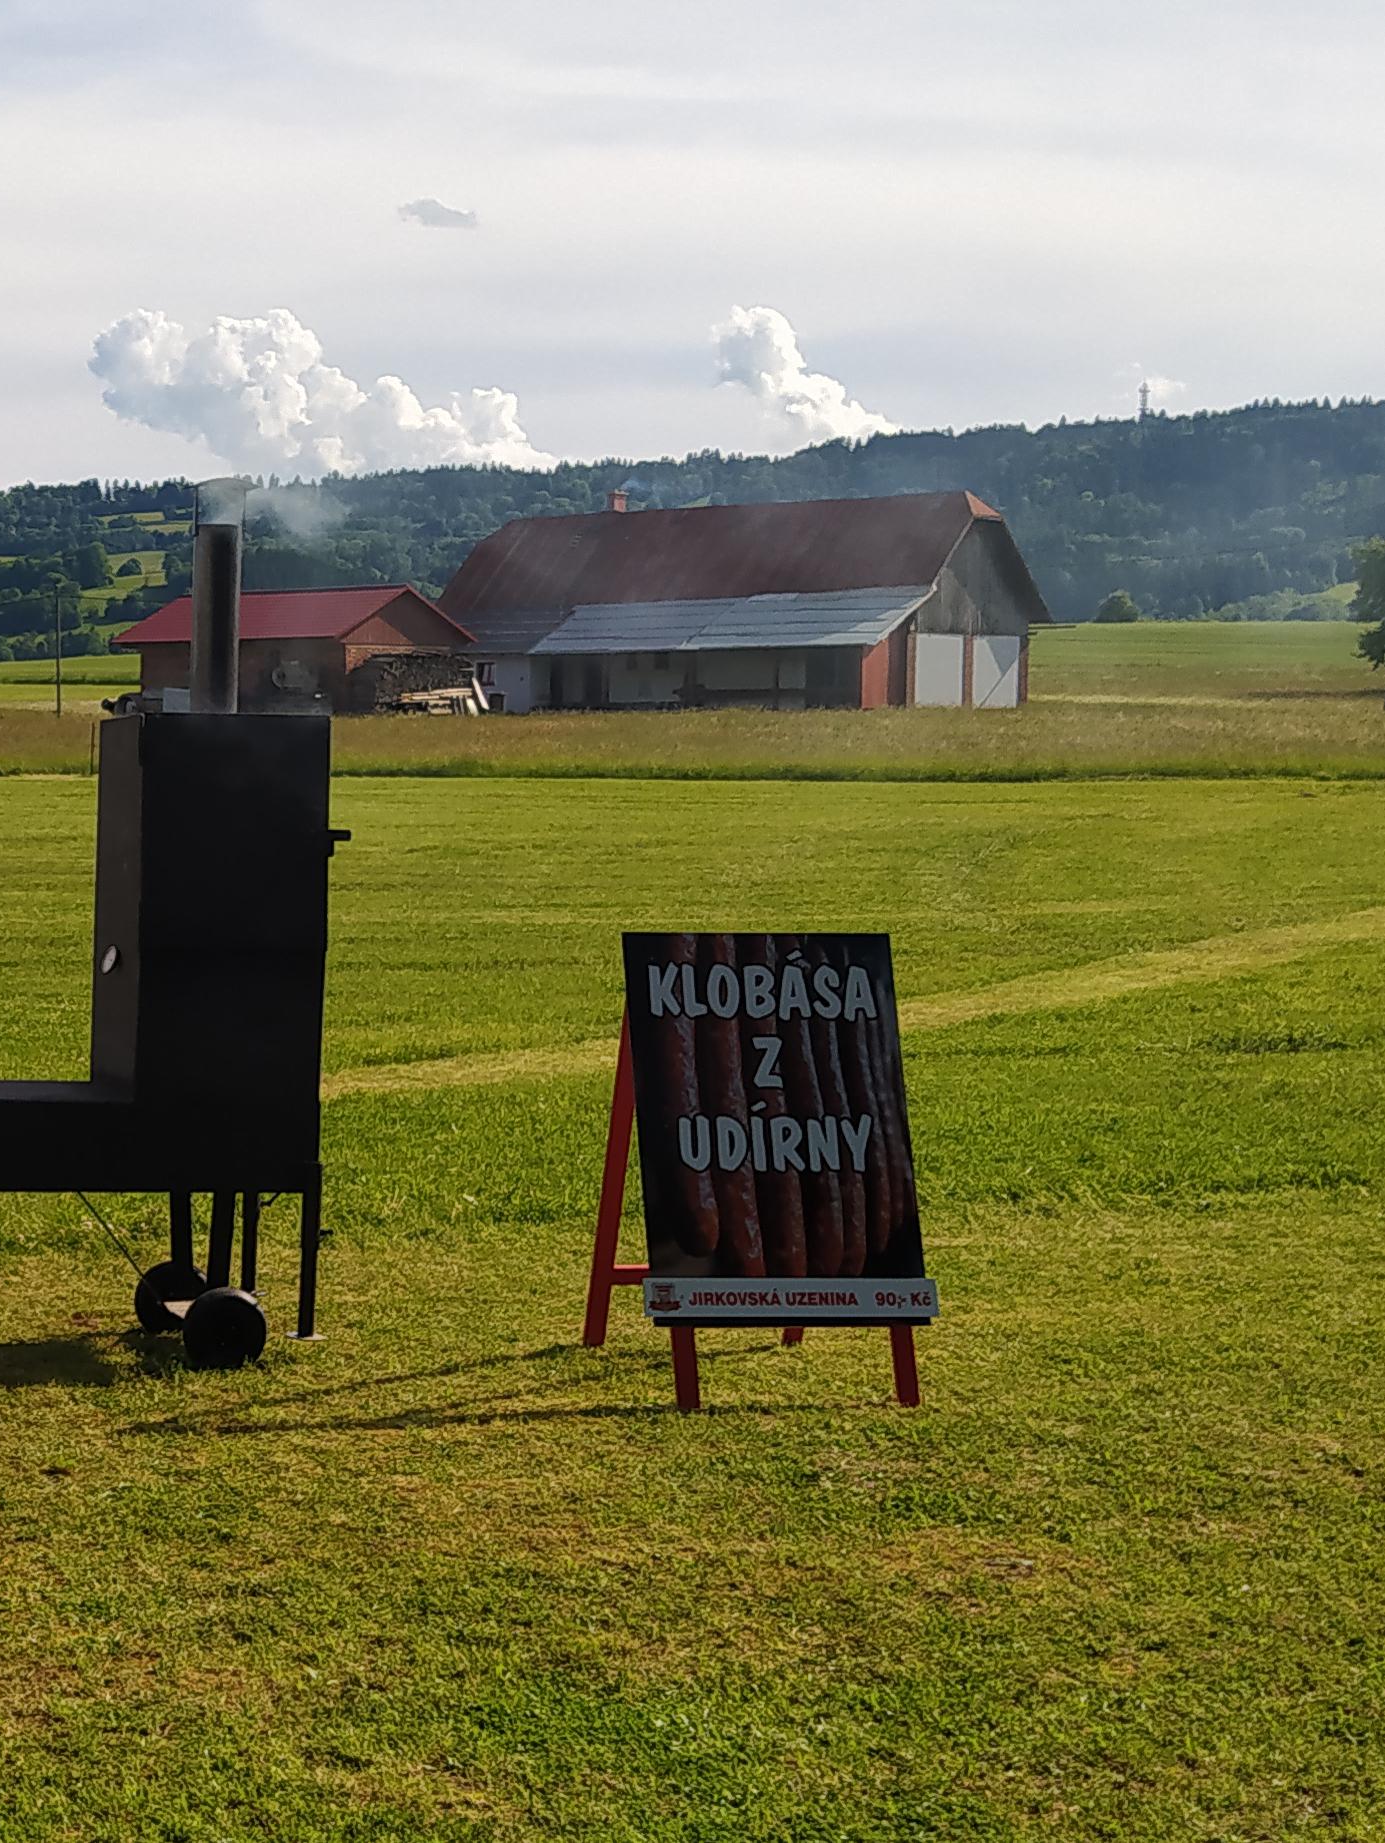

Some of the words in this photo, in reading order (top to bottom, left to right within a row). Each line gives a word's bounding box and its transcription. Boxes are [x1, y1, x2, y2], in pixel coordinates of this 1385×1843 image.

[647, 949, 878, 1022] KLOBÁSA
[751, 1036, 784, 1088] Z
[677, 1101, 872, 1173] UDÍRNY
[688, 1287, 781, 1308] JIRKOVSKÁ
[785, 1290, 859, 1307] UZENINA
[910, 1290, 932, 1308] Kč
